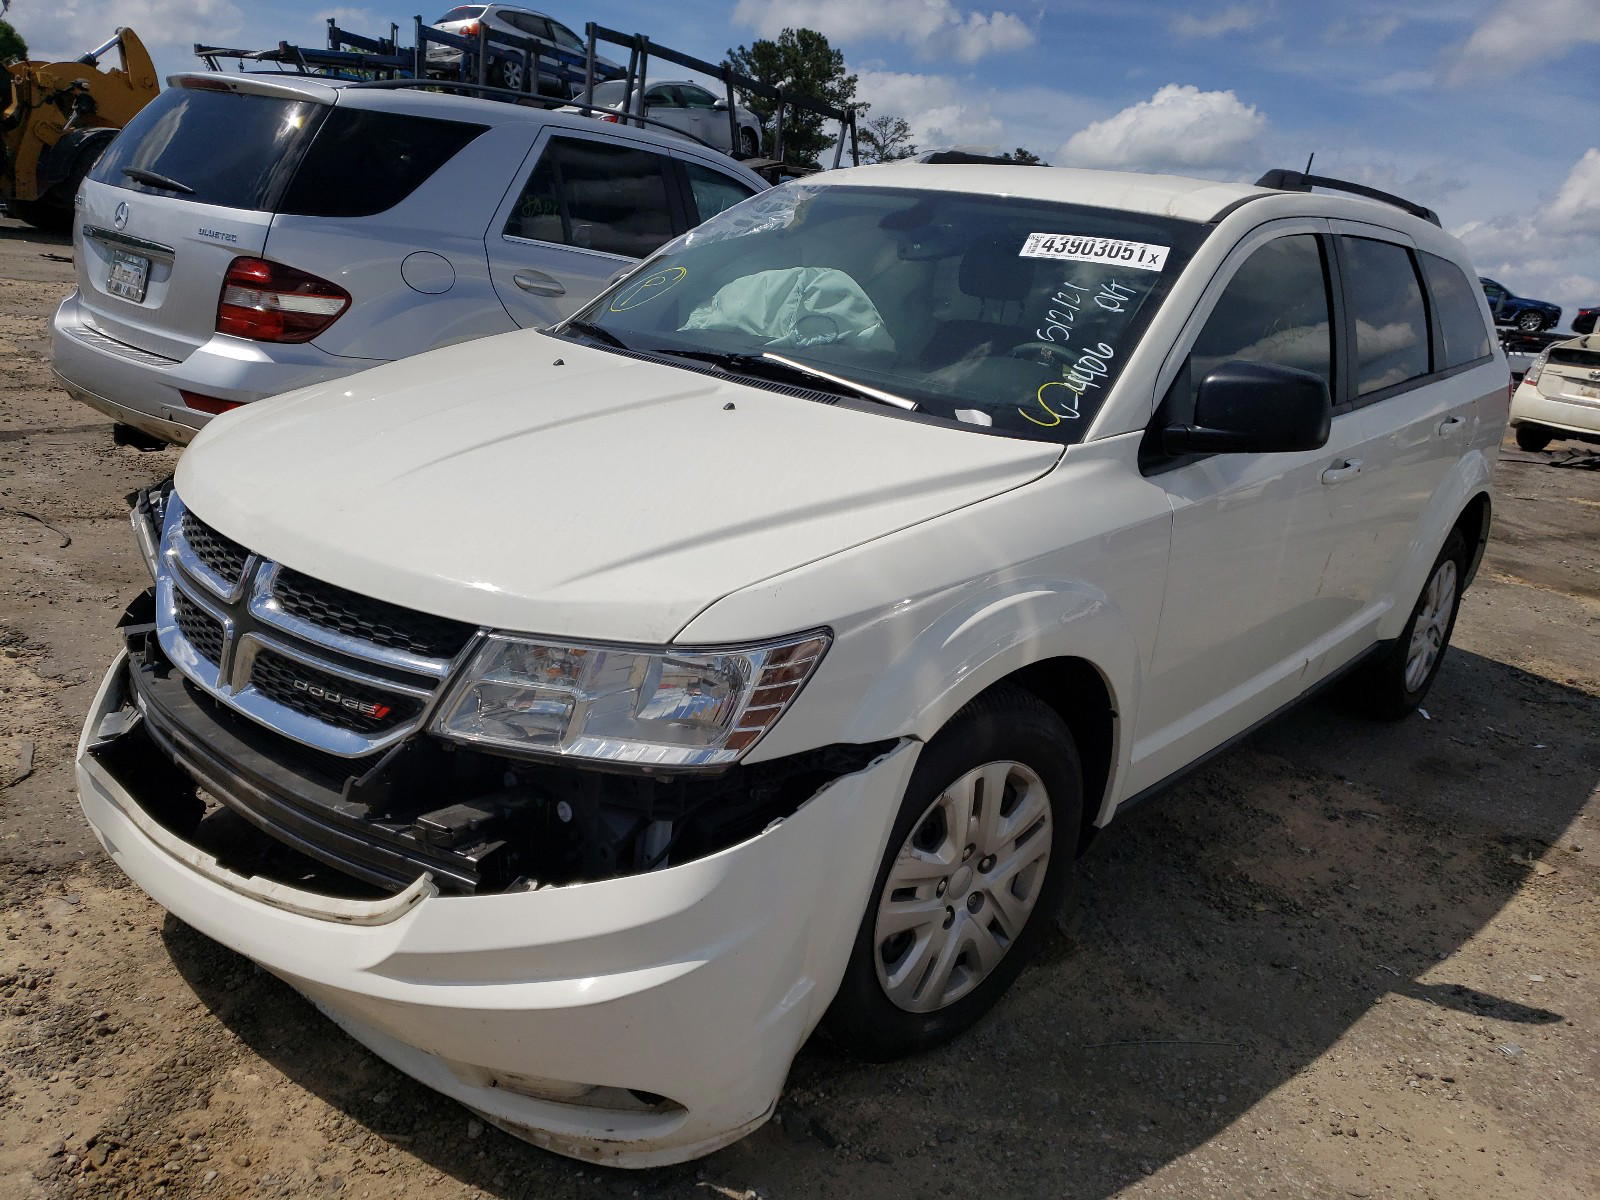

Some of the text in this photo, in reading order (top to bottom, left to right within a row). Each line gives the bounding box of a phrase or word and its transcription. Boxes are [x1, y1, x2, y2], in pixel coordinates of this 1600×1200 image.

[198, 228, 237, 242] BLUETEC
[1041, 235, 1148, 263] 43903051
[293, 679, 376, 715] DODGE
